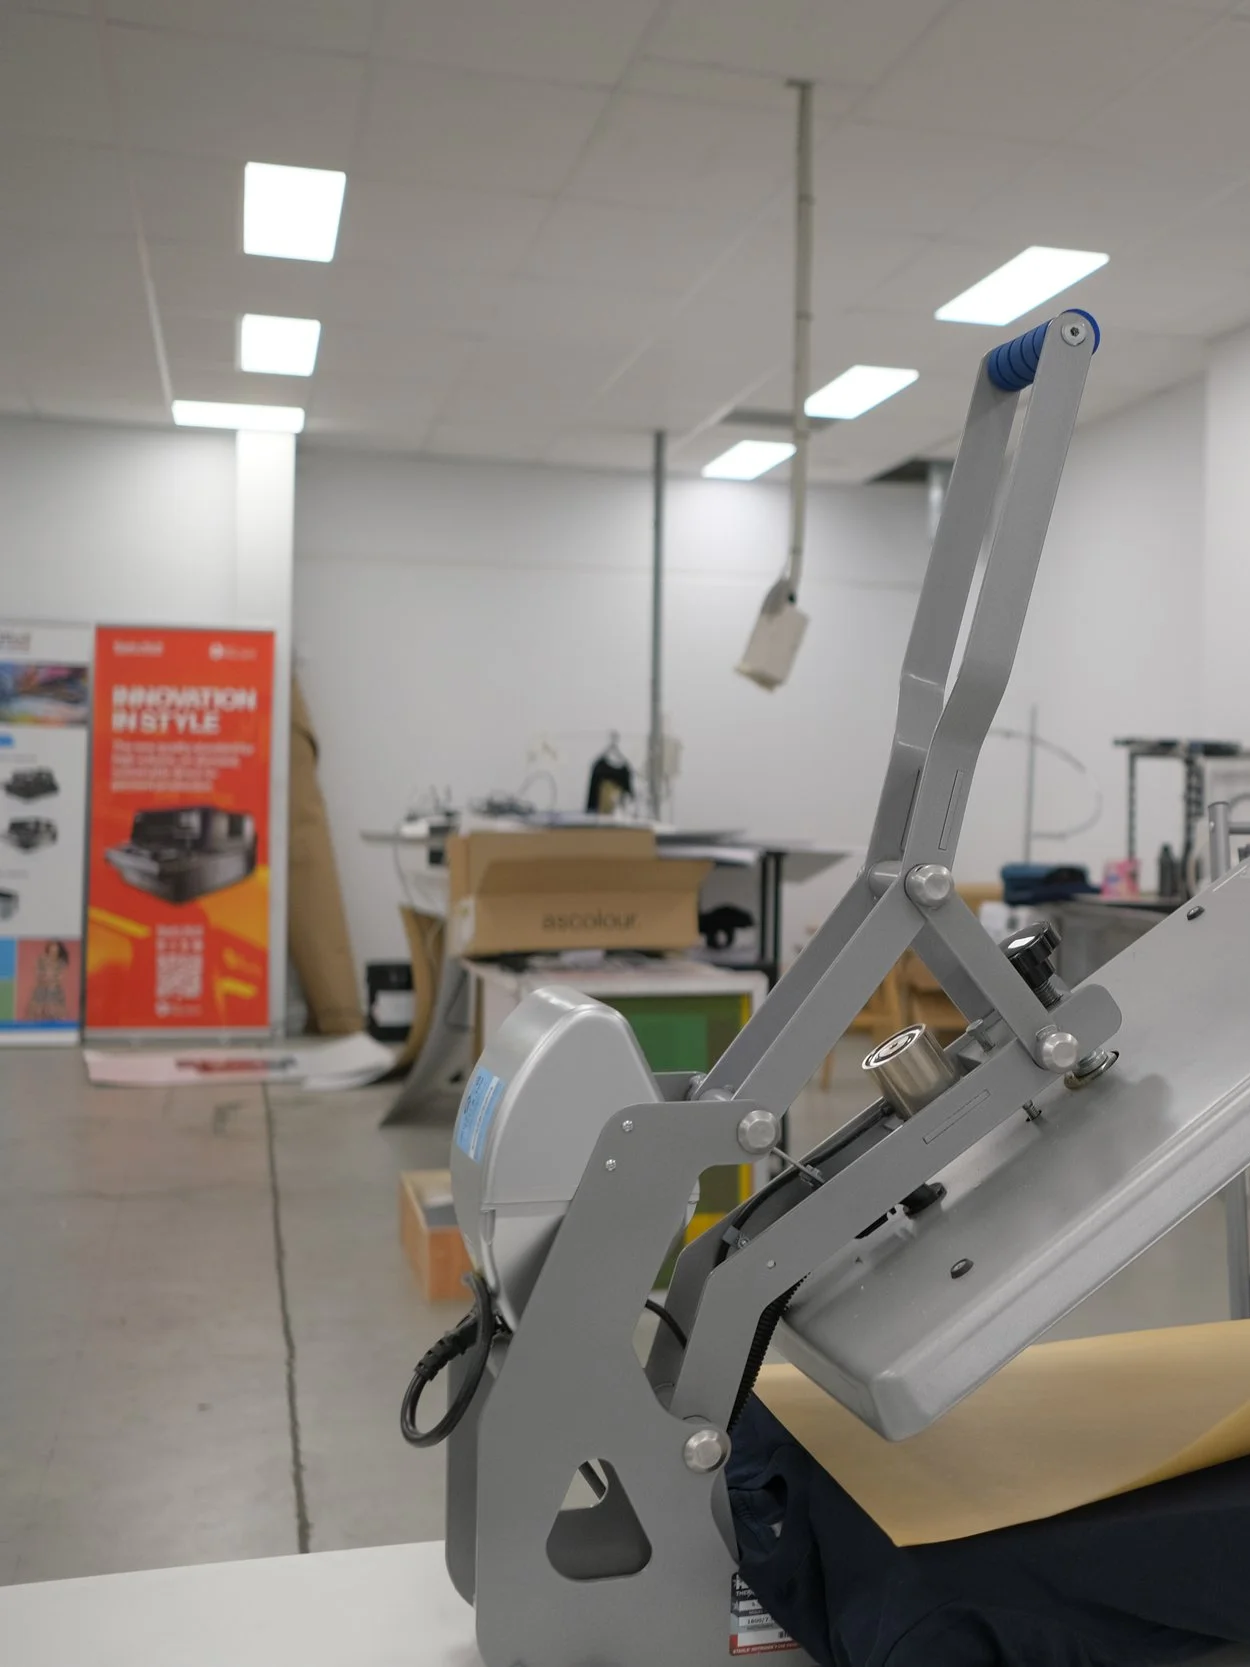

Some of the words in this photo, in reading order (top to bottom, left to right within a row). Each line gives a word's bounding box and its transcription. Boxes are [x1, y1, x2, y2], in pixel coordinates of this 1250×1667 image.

[112, 685, 257, 711] INNOVATION
[112, 710, 137, 733] IN
[141, 710, 221, 735] STYLE
